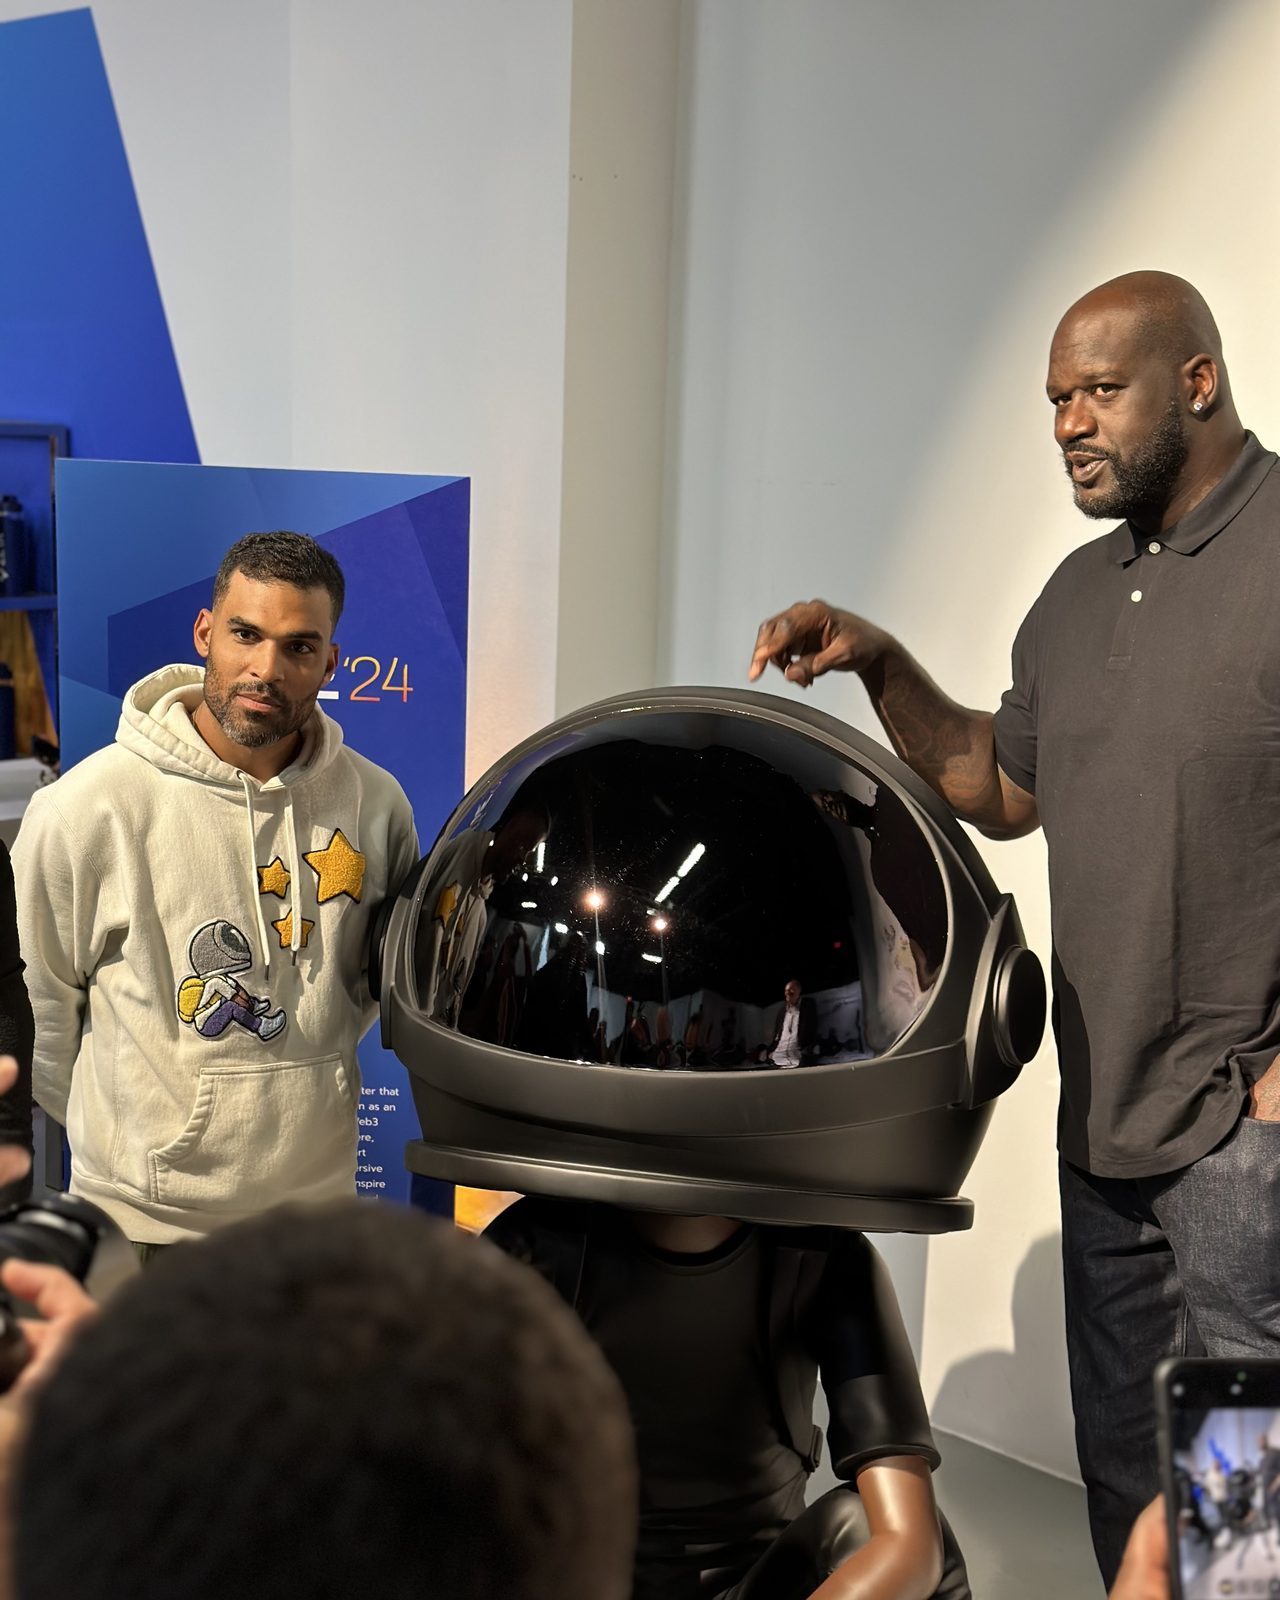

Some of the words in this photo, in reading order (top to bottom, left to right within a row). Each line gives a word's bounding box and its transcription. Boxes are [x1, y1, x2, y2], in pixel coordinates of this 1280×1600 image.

[379, 1087, 399, 1096] that
[383, 1104, 396, 1112] an
[357, 1117, 379, 1126] eb3
[359, 1134, 375, 1143] re,
[357, 1164, 383, 1172] rsive
